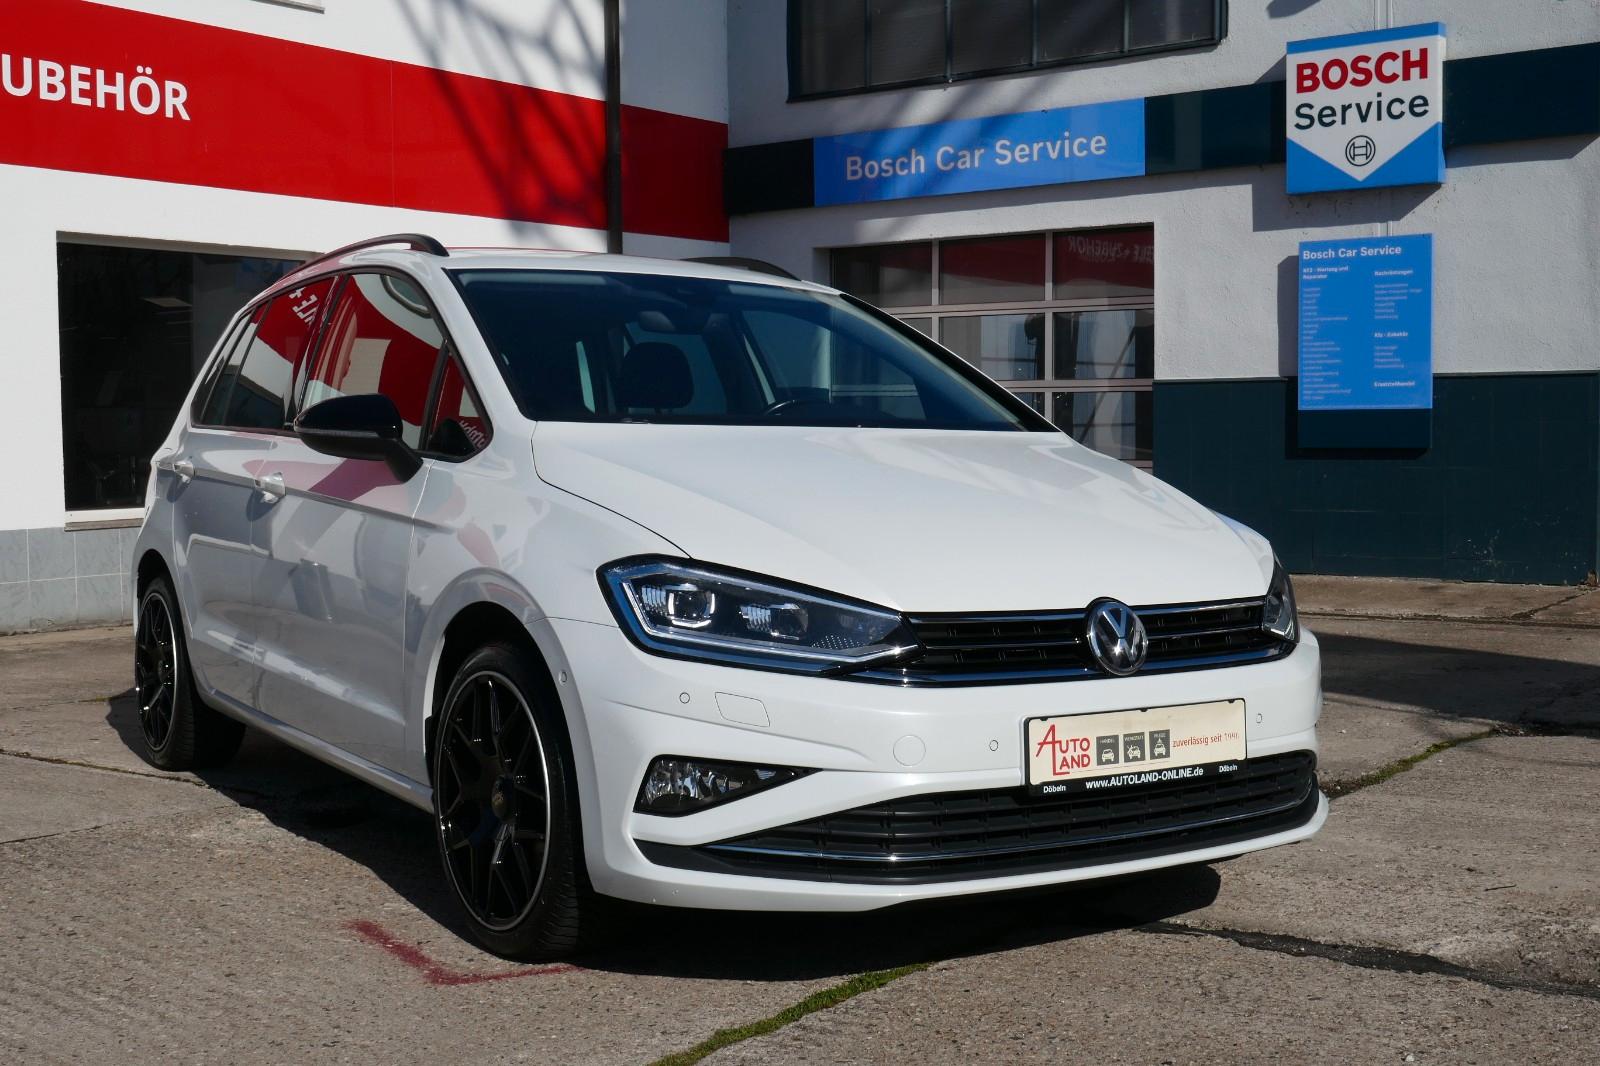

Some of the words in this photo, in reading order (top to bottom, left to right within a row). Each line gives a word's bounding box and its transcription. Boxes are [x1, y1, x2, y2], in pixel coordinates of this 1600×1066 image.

[1296, 48, 1428, 94] BOSCH
[2, 53, 190, 120] UBEHÖR
[1294, 92, 1429, 130] Service
[846, 149, 925, 181] Bosch
[936, 146, 985, 171] Car
[995, 131, 1107, 165] Service
[1303, 249, 1335, 260] Bosch
[1338, 247, 1357, 258] Car
[1360, 244, 1402, 257] Service
[1172, 736, 1209, 748] zuverlässig
[1210, 733, 1222, 744] seit
[1043, 784, 1067, 793] Döbeln
[1085, 766, 1204, 789] www.AUTOLAND-ONLINE.de
